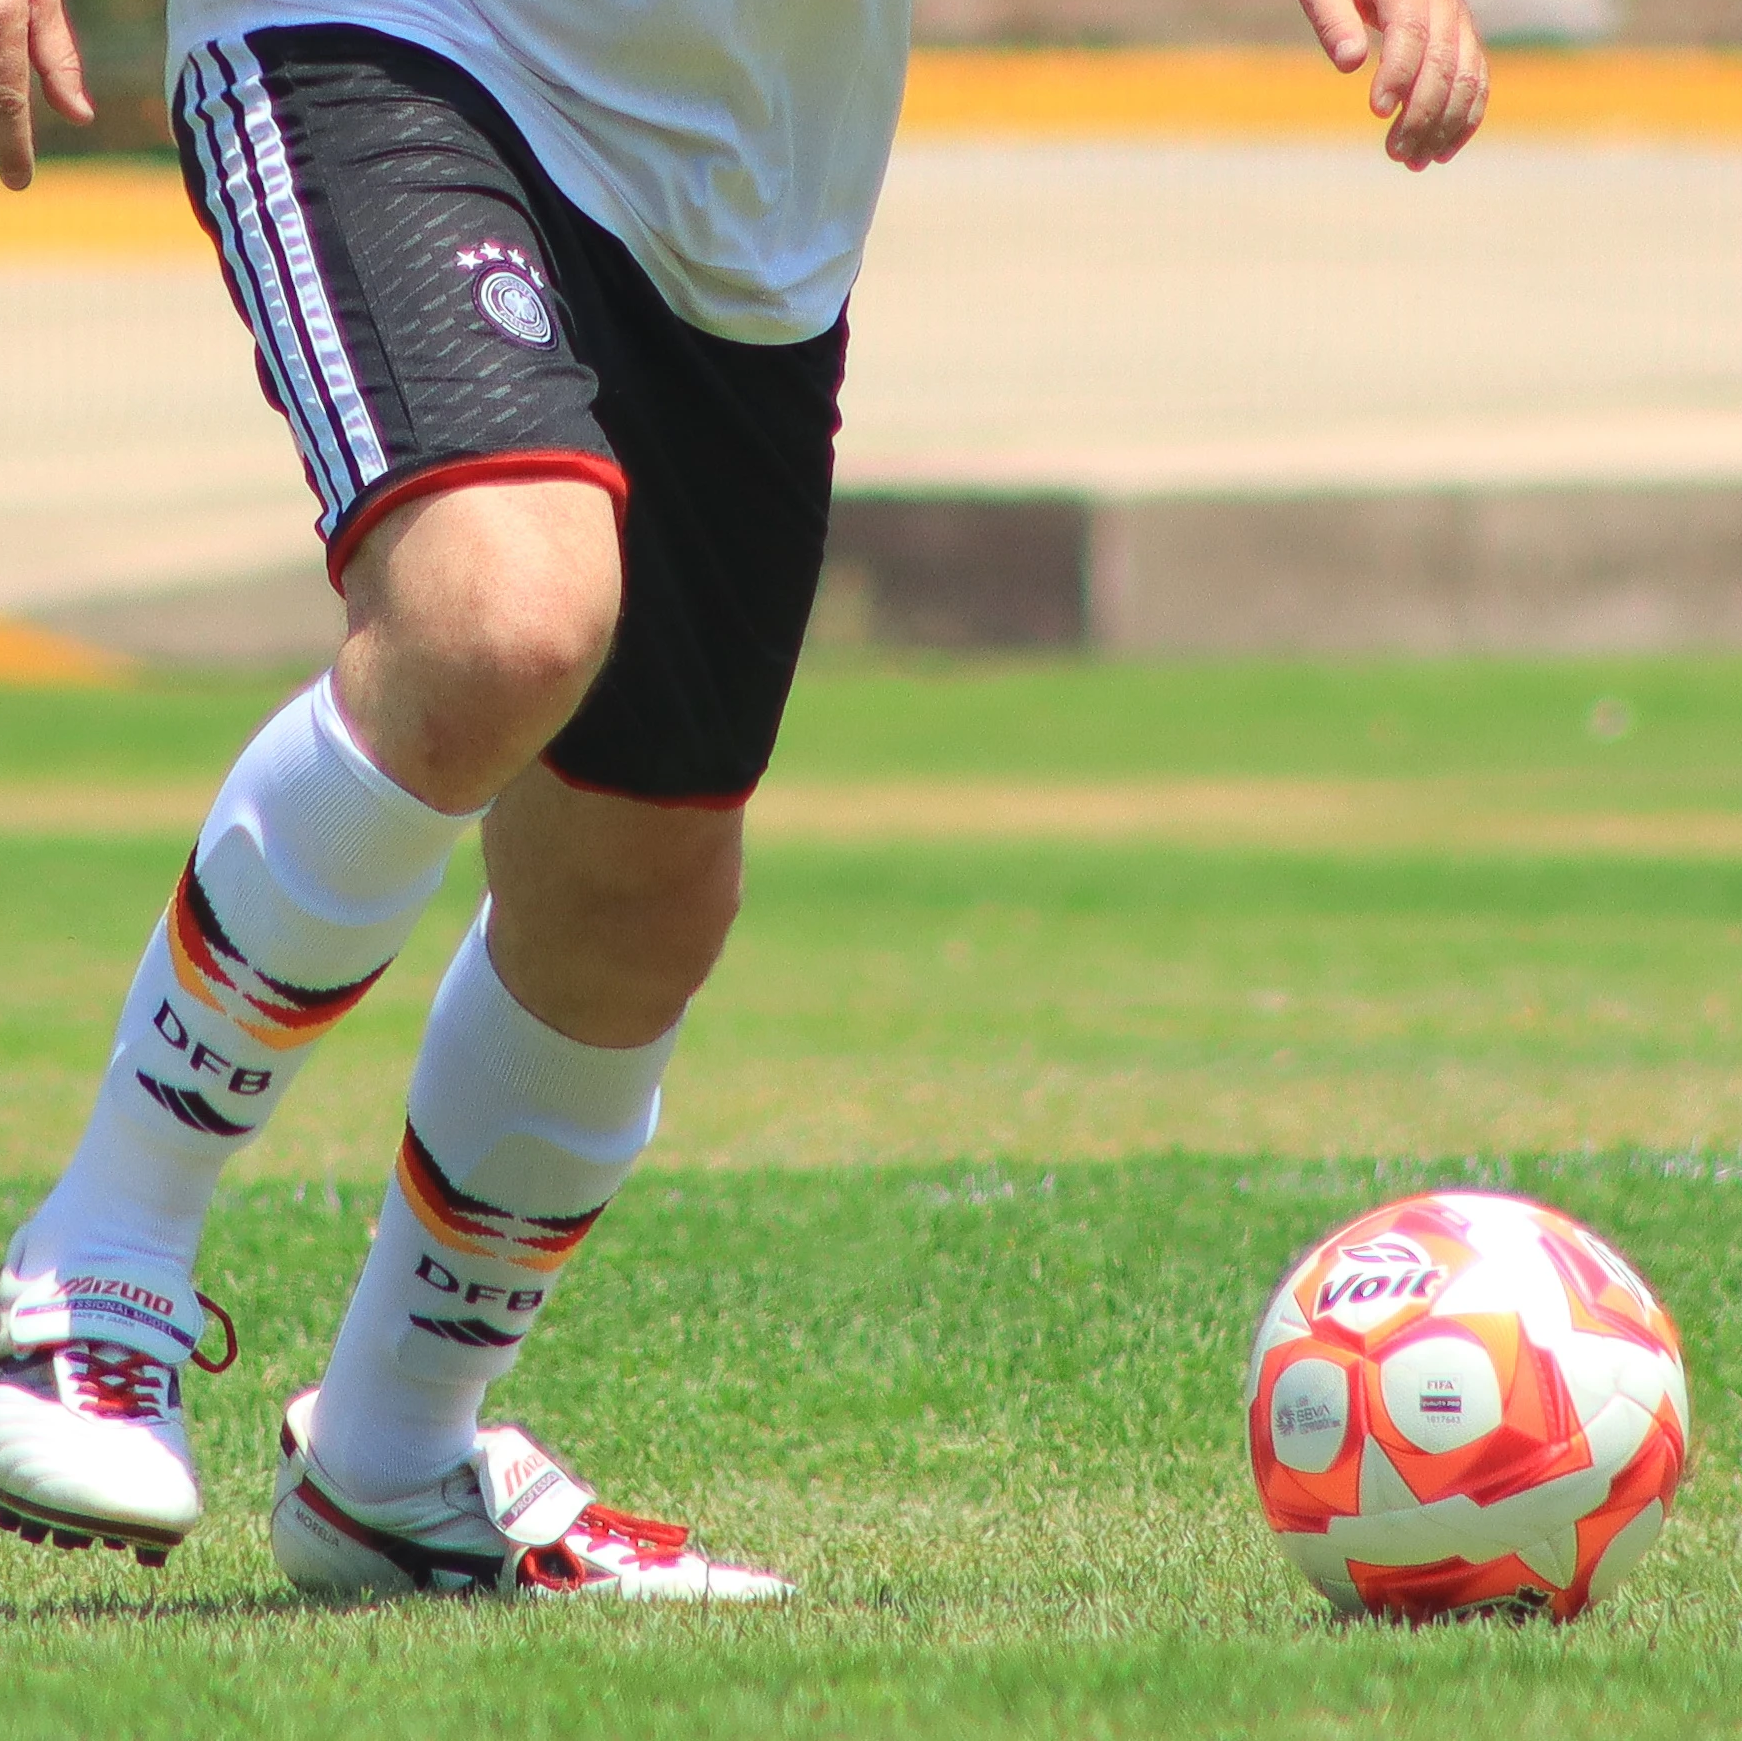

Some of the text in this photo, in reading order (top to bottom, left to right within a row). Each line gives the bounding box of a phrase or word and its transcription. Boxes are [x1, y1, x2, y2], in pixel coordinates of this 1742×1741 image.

[153, 997, 272, 1095] DFB
[415, 1253, 544, 1311] DFB
[1427, 1380, 1455, 1390] FIFA
[1296, 1404, 1331, 1422] BBVA
